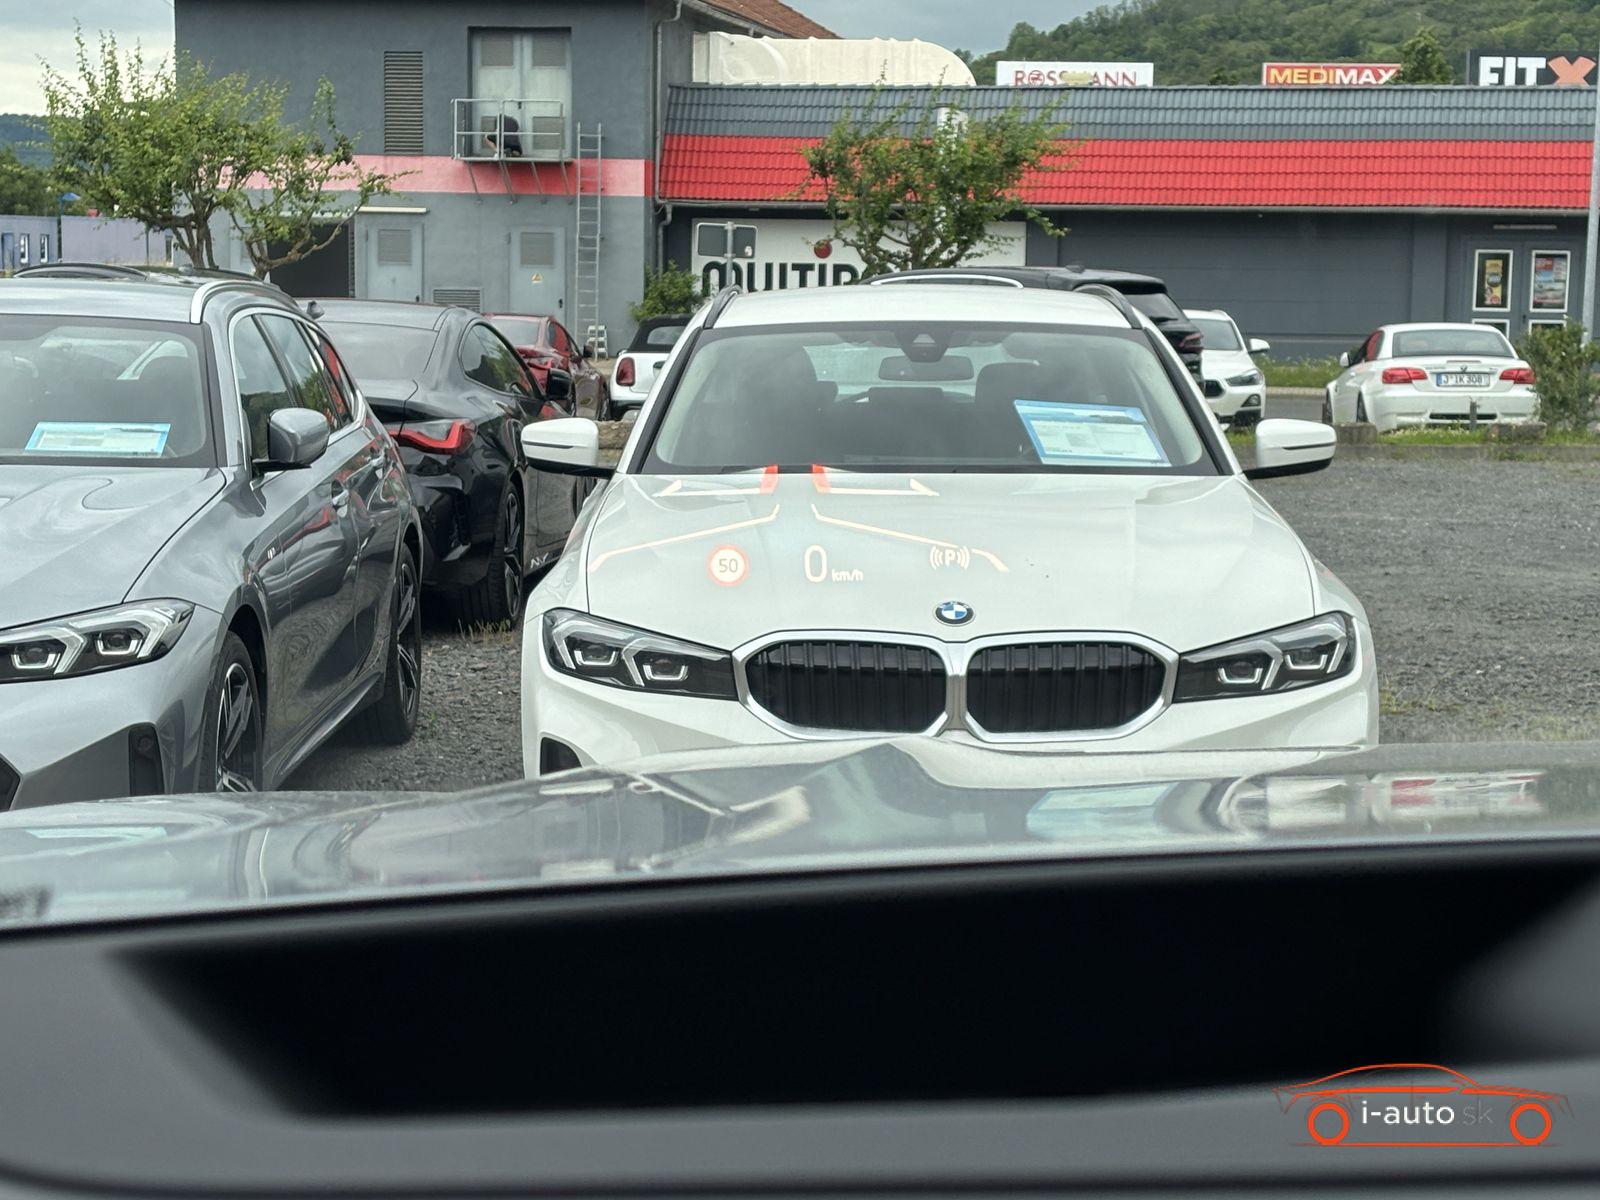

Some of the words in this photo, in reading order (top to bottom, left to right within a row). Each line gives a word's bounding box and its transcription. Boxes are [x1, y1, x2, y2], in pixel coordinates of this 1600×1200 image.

[1014, 70, 1137, 87] ROSANN
[1269, 68, 1397, 85] MEDIMAX
[718, 558, 738, 573] 50
[804, 544, 827, 583] 0
[831, 568, 864, 582] km/h
